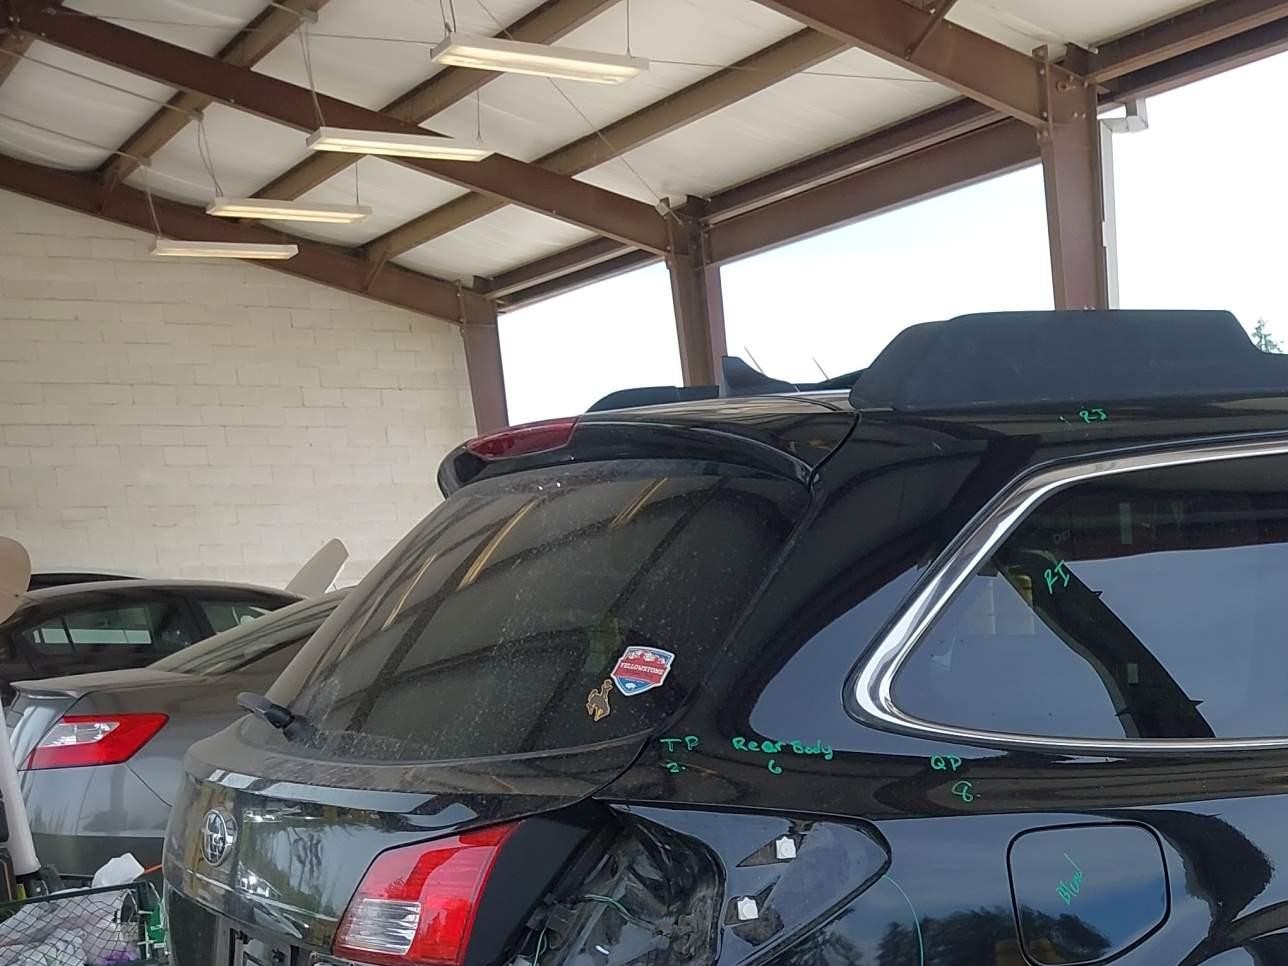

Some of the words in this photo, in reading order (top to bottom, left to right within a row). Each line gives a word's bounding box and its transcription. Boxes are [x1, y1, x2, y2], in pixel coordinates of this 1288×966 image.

[659, 735, 700, 752] TP
[732, 737, 787, 753] Rear
[790, 739, 834, 760] Body
[768, 759, 782, 774] 6
[930, 754, 962, 771] QP
